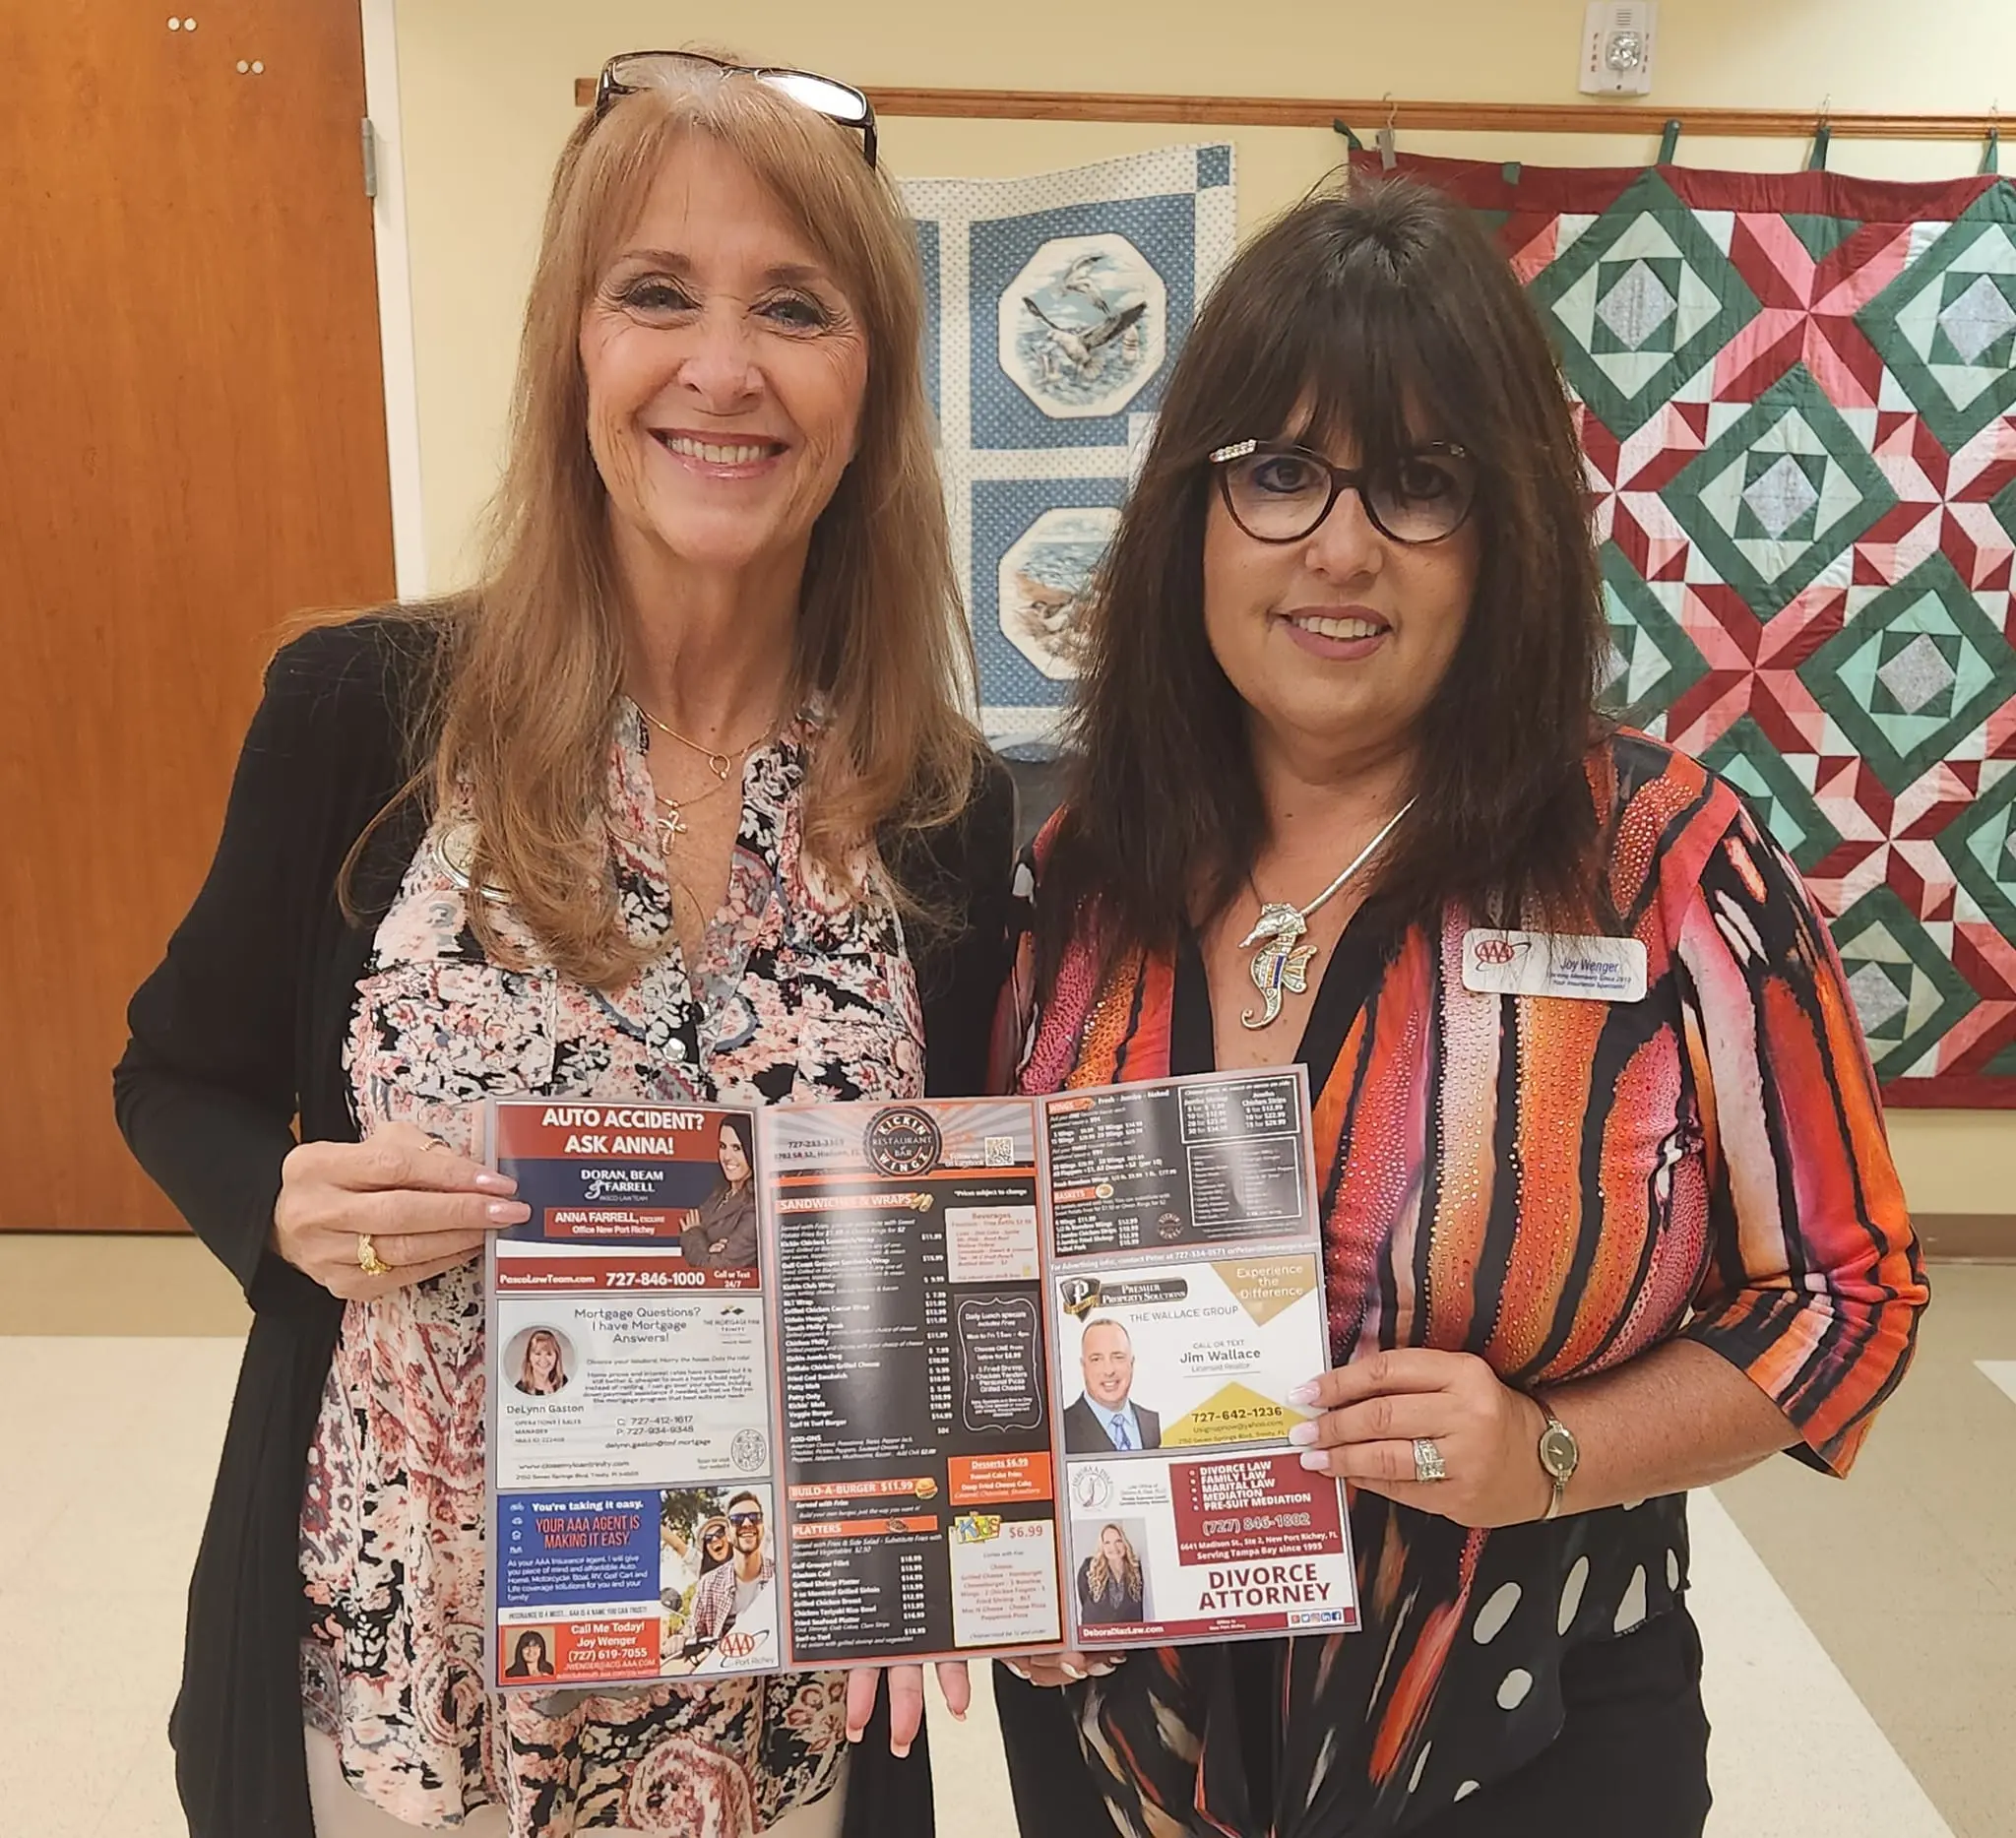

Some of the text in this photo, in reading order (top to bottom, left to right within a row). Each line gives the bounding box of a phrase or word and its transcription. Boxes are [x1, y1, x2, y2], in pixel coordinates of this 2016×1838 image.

[1480, 943, 1510, 960] AAA
[1560, 958, 1619, 973] Joy Wenger
[542, 1108, 705, 1131] AUTO ACCIDENT?
[877, 1114, 926, 1135] KICKIN
[565, 1135, 674, 1155] ASK ANNA!
[872, 1135, 932, 1146] RESTAURANT
[895, 1149, 913, 1158] BAR
[877, 1153, 929, 1173] WINGZ
[581, 1171, 663, 1181] DORAN, BEAM
[605, 1182, 655, 1192] FARRELL
[871, 1193, 913, 1206] WRAPS
[555, 1212, 639, 1224] ANNA FARRELL,
[631, 1226, 655, 1235] Richey
[1236, 1264, 1303, 1279] Experience
[500, 1273, 705, 1286] PascoLawTeam.com 727-846-1000
[1258, 1278, 1279, 1287] the
[1239, 1286, 1303, 1299] Difference
[575, 1307, 701, 1320] Mortgage Questions?
[1130, 1305, 1239, 1322] THE WALLACE GROUP
[599, 1321, 628, 1330] have
[632, 1321, 686, 1331] Mortgage
[613, 1333, 669, 1343] Answers!
[1179, 1349, 1261, 1363] Jim Wallace
[507, 1405, 584, 1415] DeLynn Gaston
[1191, 1407, 1283, 1423] 727-642-1236
[972, 1460, 1005, 1470] Desserts
[1200, 1461, 1272, 1476] DIVORCE LAW
[1201, 1471, 1267, 1485] FAMILY LAW
[791, 1481, 914, 1496] BUILD-A-BURGER $11.99
[1202, 1479, 1276, 1493] MARITAL LAW
[1203, 1489, 1263, 1502] MEDIATION
[1204, 1493, 1311, 1511] PRE-SUIT MEDIATION
[532, 1502, 566, 1512] You're
[569, 1501, 602, 1511] taking
[616, 1500, 643, 1510] easy.
[536, 1515, 640, 1533] YOUR AAA AGENT IS
[792, 1524, 842, 1535] PLATTERS
[1202, 1519, 1240, 1536] (727)
[1009, 1526, 1043, 1538] $6.99
[544, 1533, 587, 1549] MAKING
[589, 1533, 598, 1547] IT
[1199, 1539, 1230, 1550] Madison
[1284, 1534, 1299, 1543] Port
[1300, 1532, 1328, 1541] Richey,
[1197, 1542, 1323, 1560] Serving Tampa Bay since 1995
[1208, 1563, 1317, 1590] DIVORCE
[1198, 1582, 1331, 1611] ATTORNEY
[571, 1621, 645, 1634] Call Me Today!
[1083, 1625, 1164, 1637] DeboraDiazLaw.com
[577, 1636, 636, 1648] Joy Wenger
[723, 1634, 753, 1656] AAA
[568, 1648, 647, 1662] (727) 619-7055
